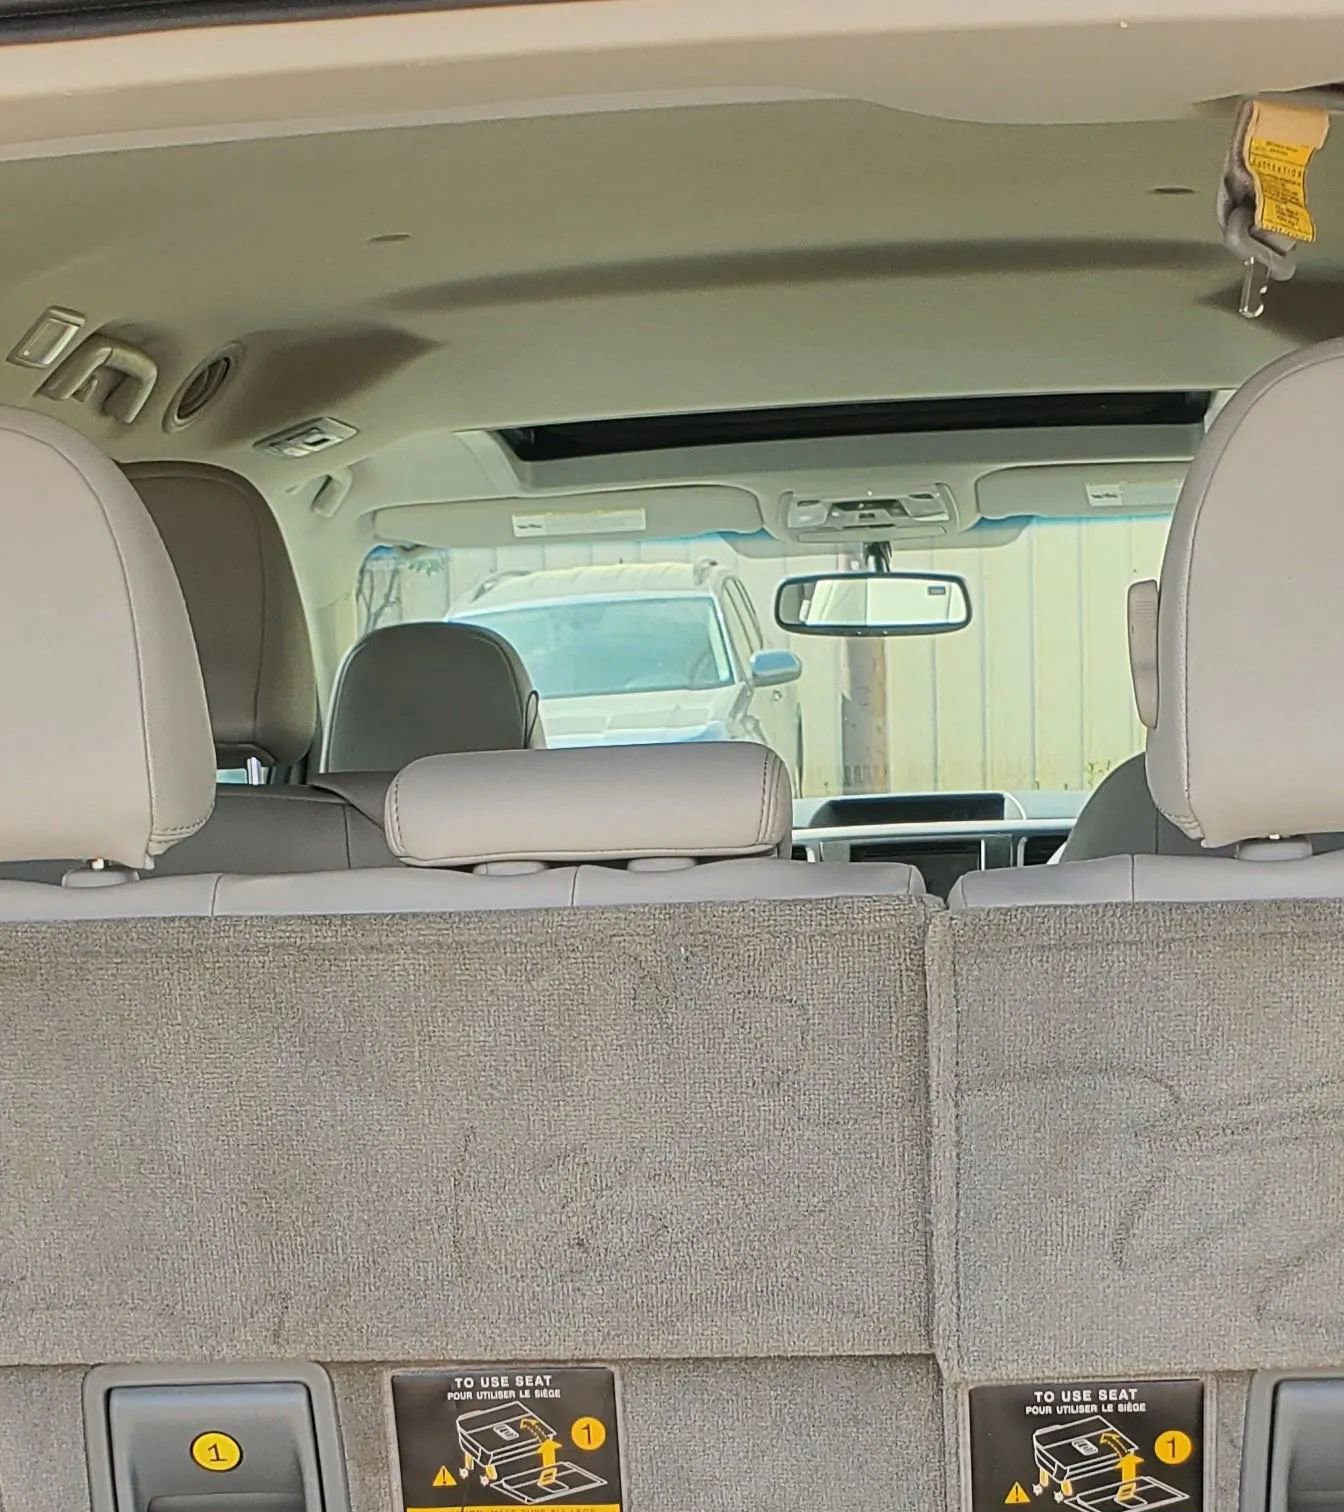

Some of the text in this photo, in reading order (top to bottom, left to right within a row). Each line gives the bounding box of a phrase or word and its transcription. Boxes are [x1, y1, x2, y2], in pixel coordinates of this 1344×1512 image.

[455, 1375, 552, 1387] TO USE SEAT
[447, 1392, 472, 1400] POUR
[477, 1391, 515, 1400] UTILISER
[520, 1390, 530, 1398] LE
[1034, 1389, 1138, 1402] TO USE SEAT
[1026, 1405, 1052, 1414] POUR
[1057, 1405, 1097, 1414] UTILISER
[1102, 1404, 1113, 1412] LE
[582, 1424, 592, 1445] 1
[208, 1443, 227, 1462] 1
[1166, 1436, 1177, 1458] 1
